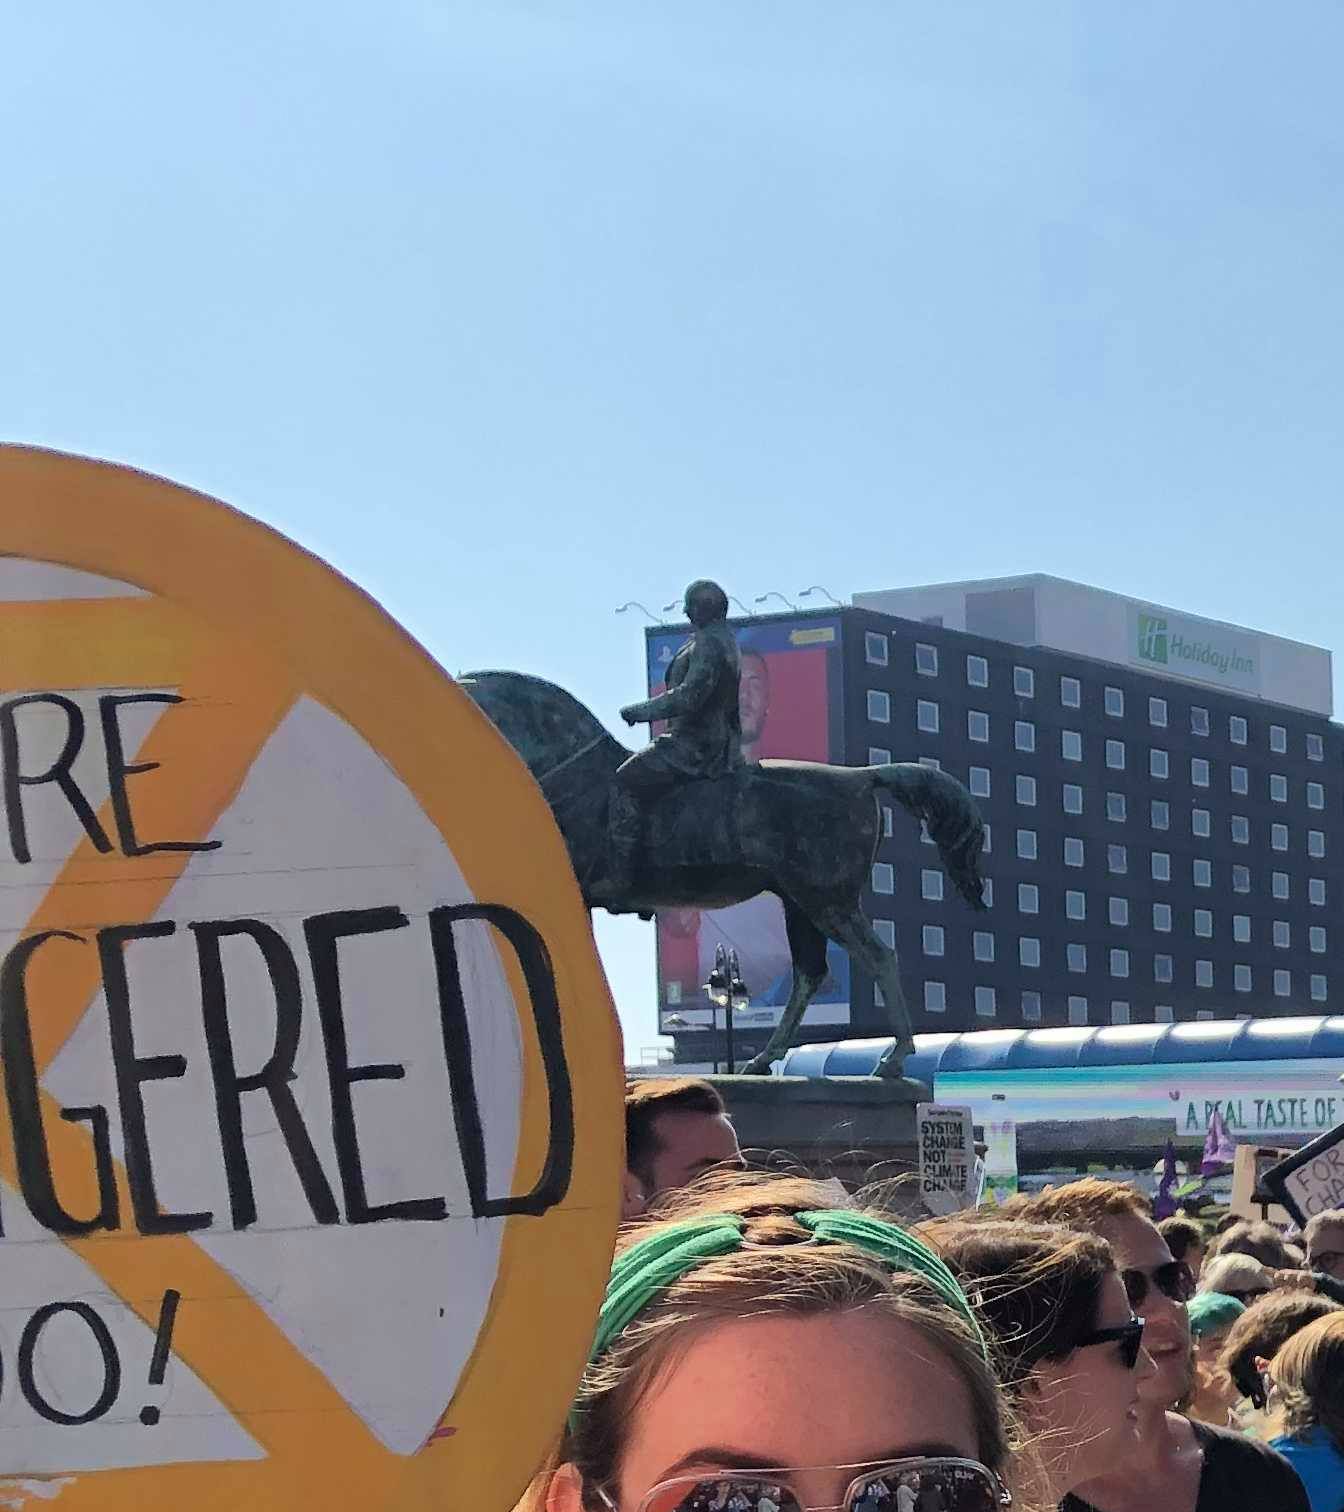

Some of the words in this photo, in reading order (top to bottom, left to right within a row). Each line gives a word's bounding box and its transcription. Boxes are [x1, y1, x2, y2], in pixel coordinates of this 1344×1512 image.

[1170, 633, 1229, 674] Holiday
[1231, 648, 1255, 674] Inn
[0, 904, 575, 1234] GERED
[1186, 1101, 1199, 1130] A
[1253, 1097, 1308, 1129] TASTE
[1314, 1096, 1337, 1128] OF
[921, 1121, 963, 1135] SYSTEM
[922, 1135, 966, 1149] CHANGE
[923, 1149, 946, 1163] NOT
[923, 1164, 968, 1178] CLIMATE
[0, 1290, 181, 1427] O!
